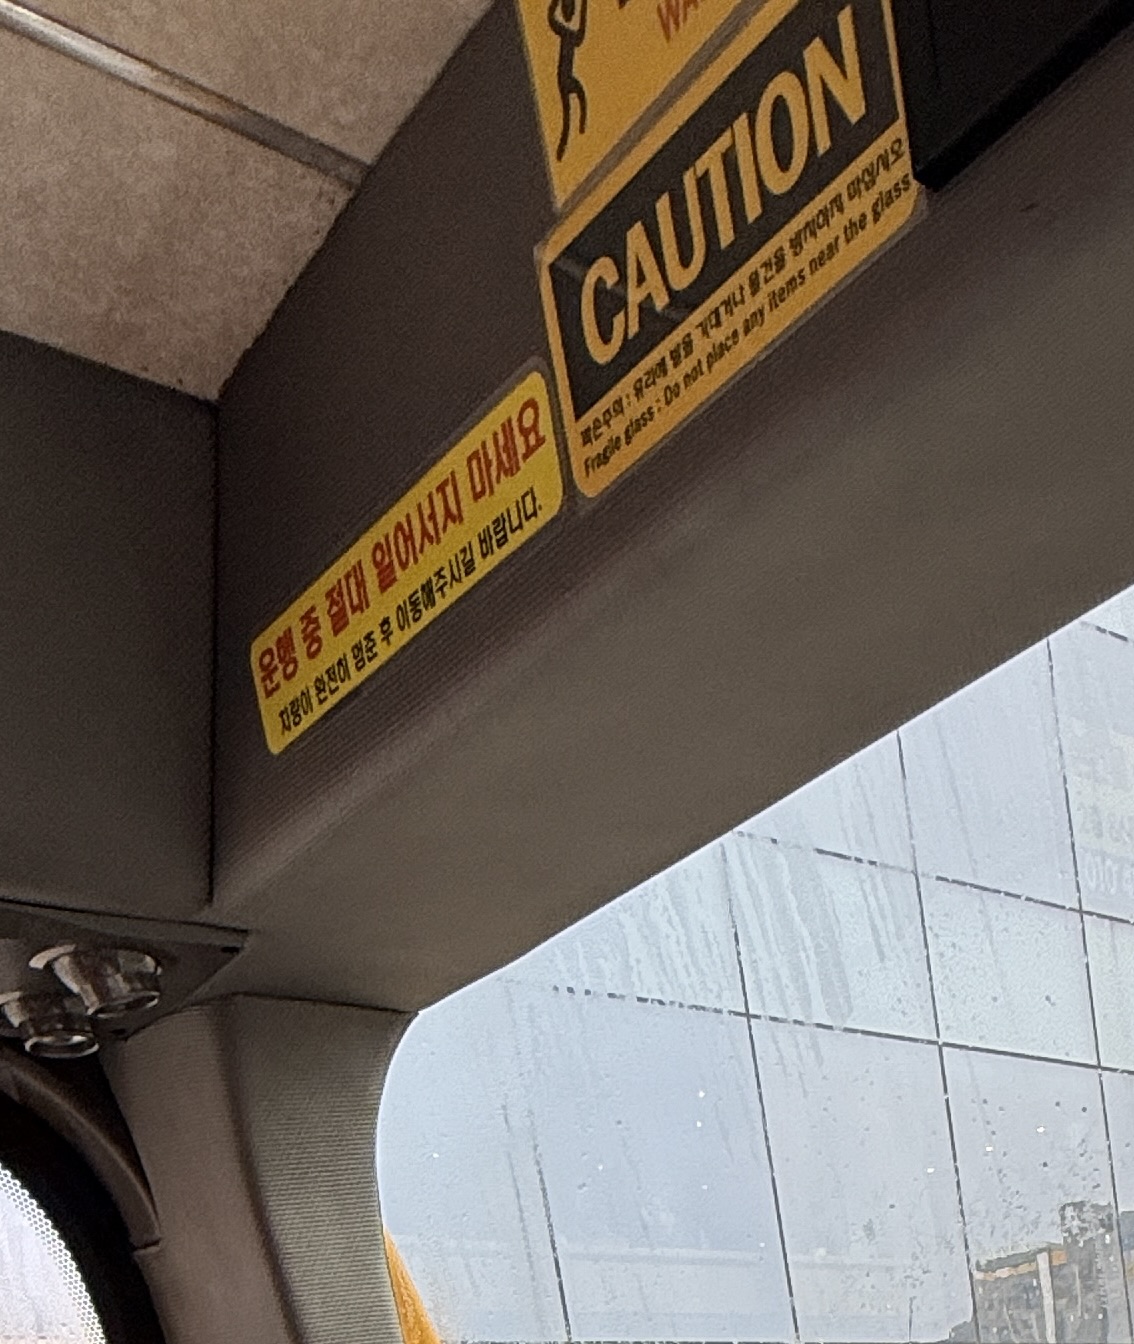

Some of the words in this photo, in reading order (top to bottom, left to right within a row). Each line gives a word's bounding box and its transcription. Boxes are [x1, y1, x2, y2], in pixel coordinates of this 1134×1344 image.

[580, 395, 624, 447] 파손주의
[633, 356, 668, 401] 유리에
[695, 284, 746, 338] 기대거나
[749, 245, 787, 297] 물건을
[847, 138, 906, 202] 마십시오
[581, 4, 866, 364] CAUTION
[584, 435, 621, 478] Fragile
[624, 406, 655, 446] glass
[663, 382, 681, 407] Do
[683, 358, 704, 390] not
[706, 328, 740, 374] place
[742, 304, 765, 339] any
[767, 267, 805, 312] items
[809, 236, 840, 276] near
[843, 212, 868, 246] the
[871, 172, 911, 225] glass
[258, 626, 298, 699] 운행
[300, 604, 323, 660] 중
[325, 559, 370, 637] 절대
[371, 470, 464, 594] 일어서지
[466, 397, 546, 503] 마세요
[278, 686, 314, 735] 차량이
[313, 652, 351, 705] 완전히
[351, 630, 378, 672] 멈춘
[379, 616, 393, 646] 후
[395, 541, 477, 631] 이동해주시길
[477, 486, 543, 560] 바랍니다.
